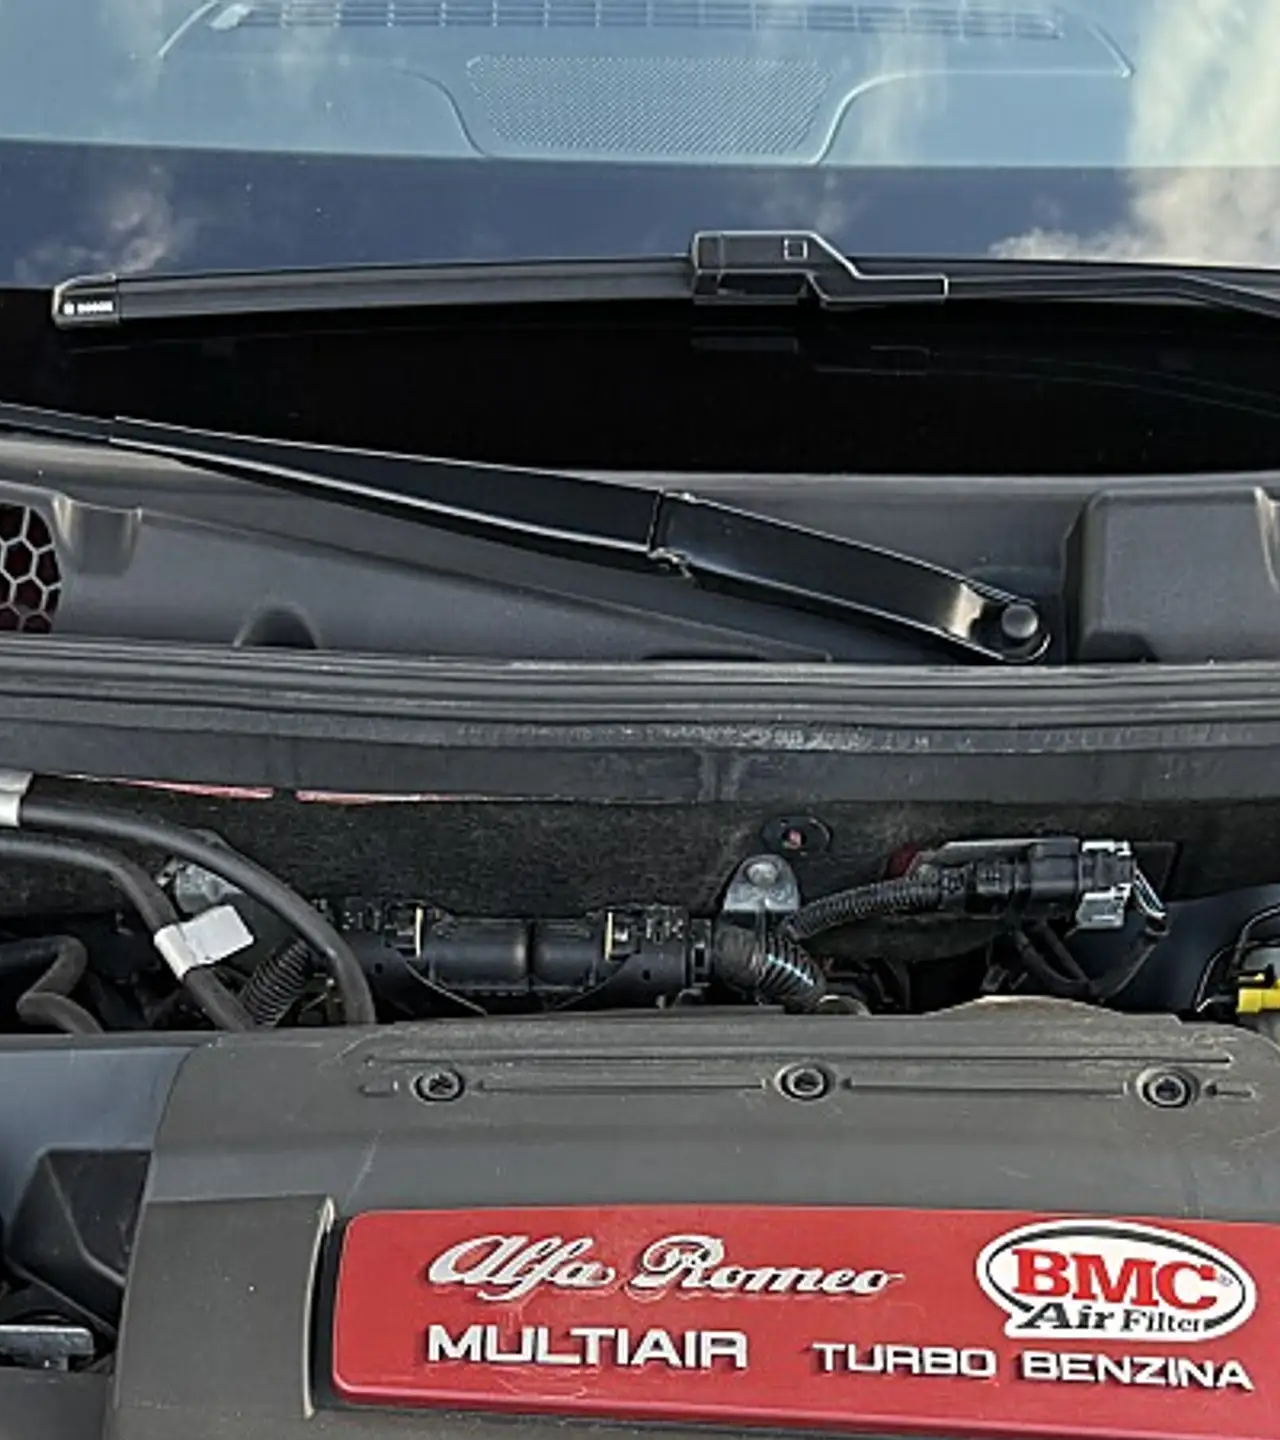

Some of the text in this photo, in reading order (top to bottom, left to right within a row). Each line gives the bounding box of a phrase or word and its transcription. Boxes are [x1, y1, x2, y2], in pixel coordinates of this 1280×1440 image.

[429, 1234, 905, 1301] Alfa Romeo
[1012, 1248, 1218, 1310] BMC
[1016, 1302, 1199, 1334] Air Filter
[427, 1325, 748, 1368] MULTIAIR
[817, 1343, 1254, 1390] TURBO BENZINA
